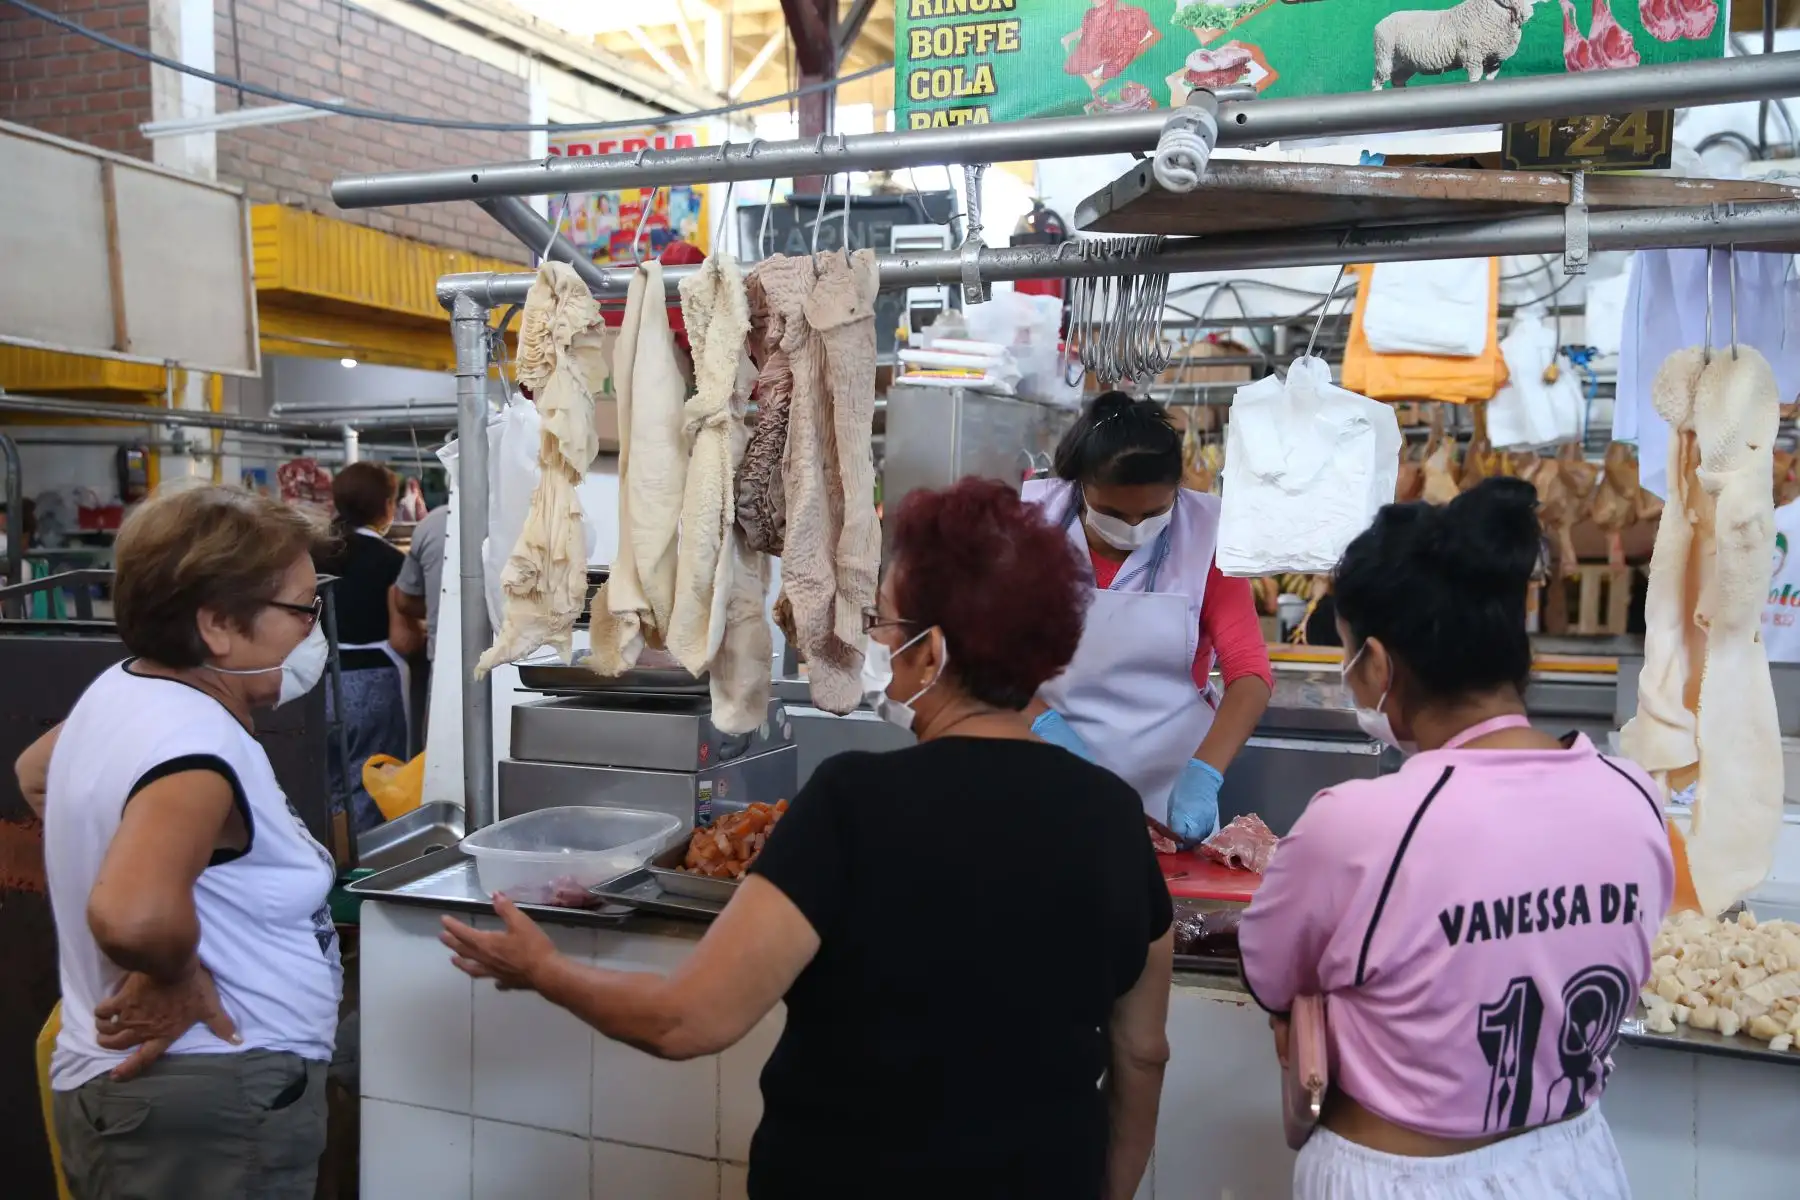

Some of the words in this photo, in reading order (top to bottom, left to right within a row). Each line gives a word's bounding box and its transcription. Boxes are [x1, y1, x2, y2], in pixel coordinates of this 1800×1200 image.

[909, 20, 1020, 60] BOFFE
[909, 64, 996, 100] COLA
[1525, 108, 1654, 157] 124
[1437, 883, 1592, 947] VANESSA
